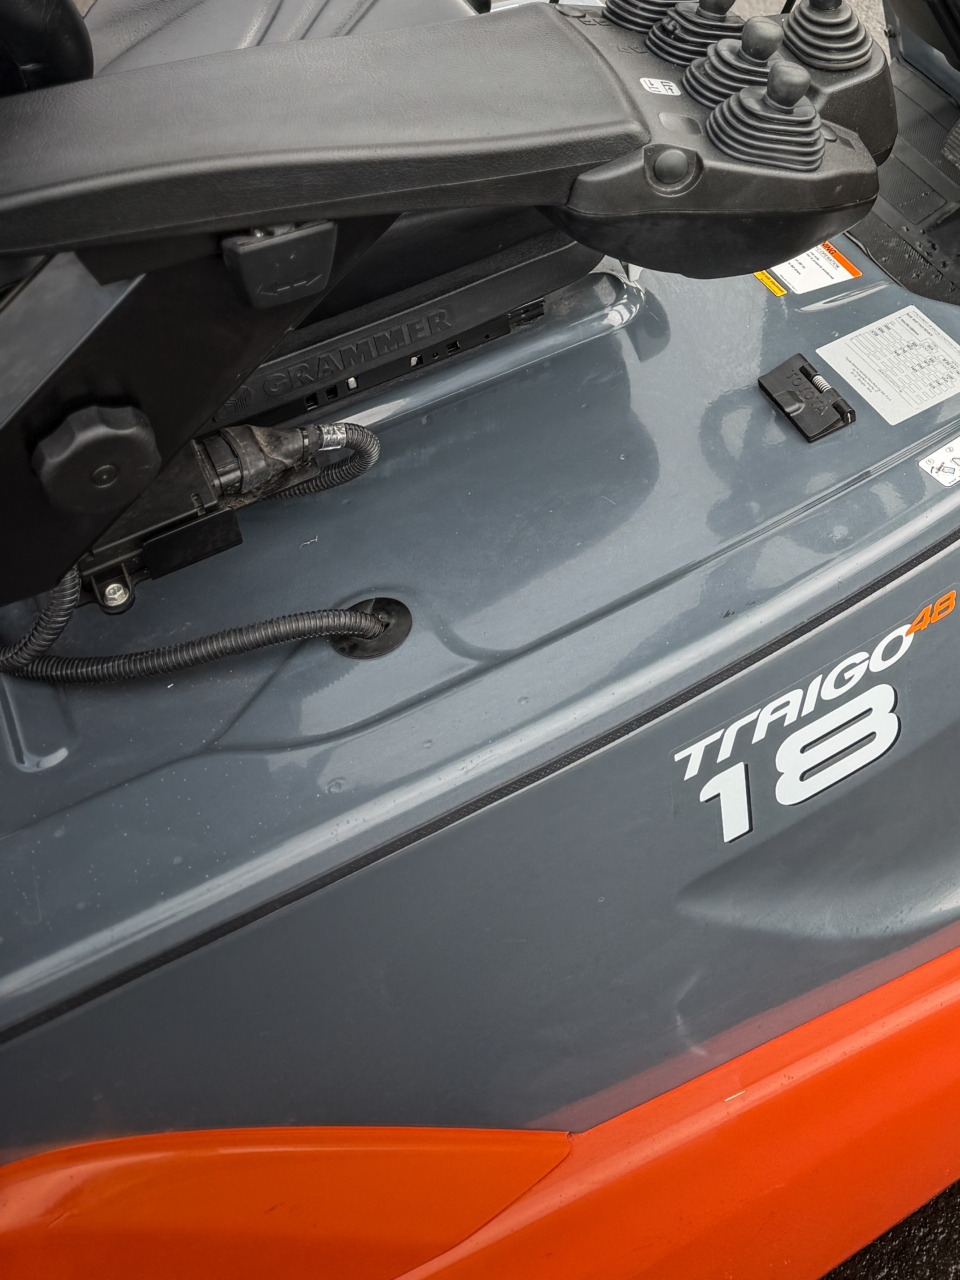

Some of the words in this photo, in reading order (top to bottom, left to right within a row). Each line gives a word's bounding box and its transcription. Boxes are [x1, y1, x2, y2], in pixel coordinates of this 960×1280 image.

[263, 309, 451, 396] GRAMMER
[786, 369, 828, 416] TOYOTA
[905, 590, 957, 637] 48
[700, 684, 902, 843] 18
